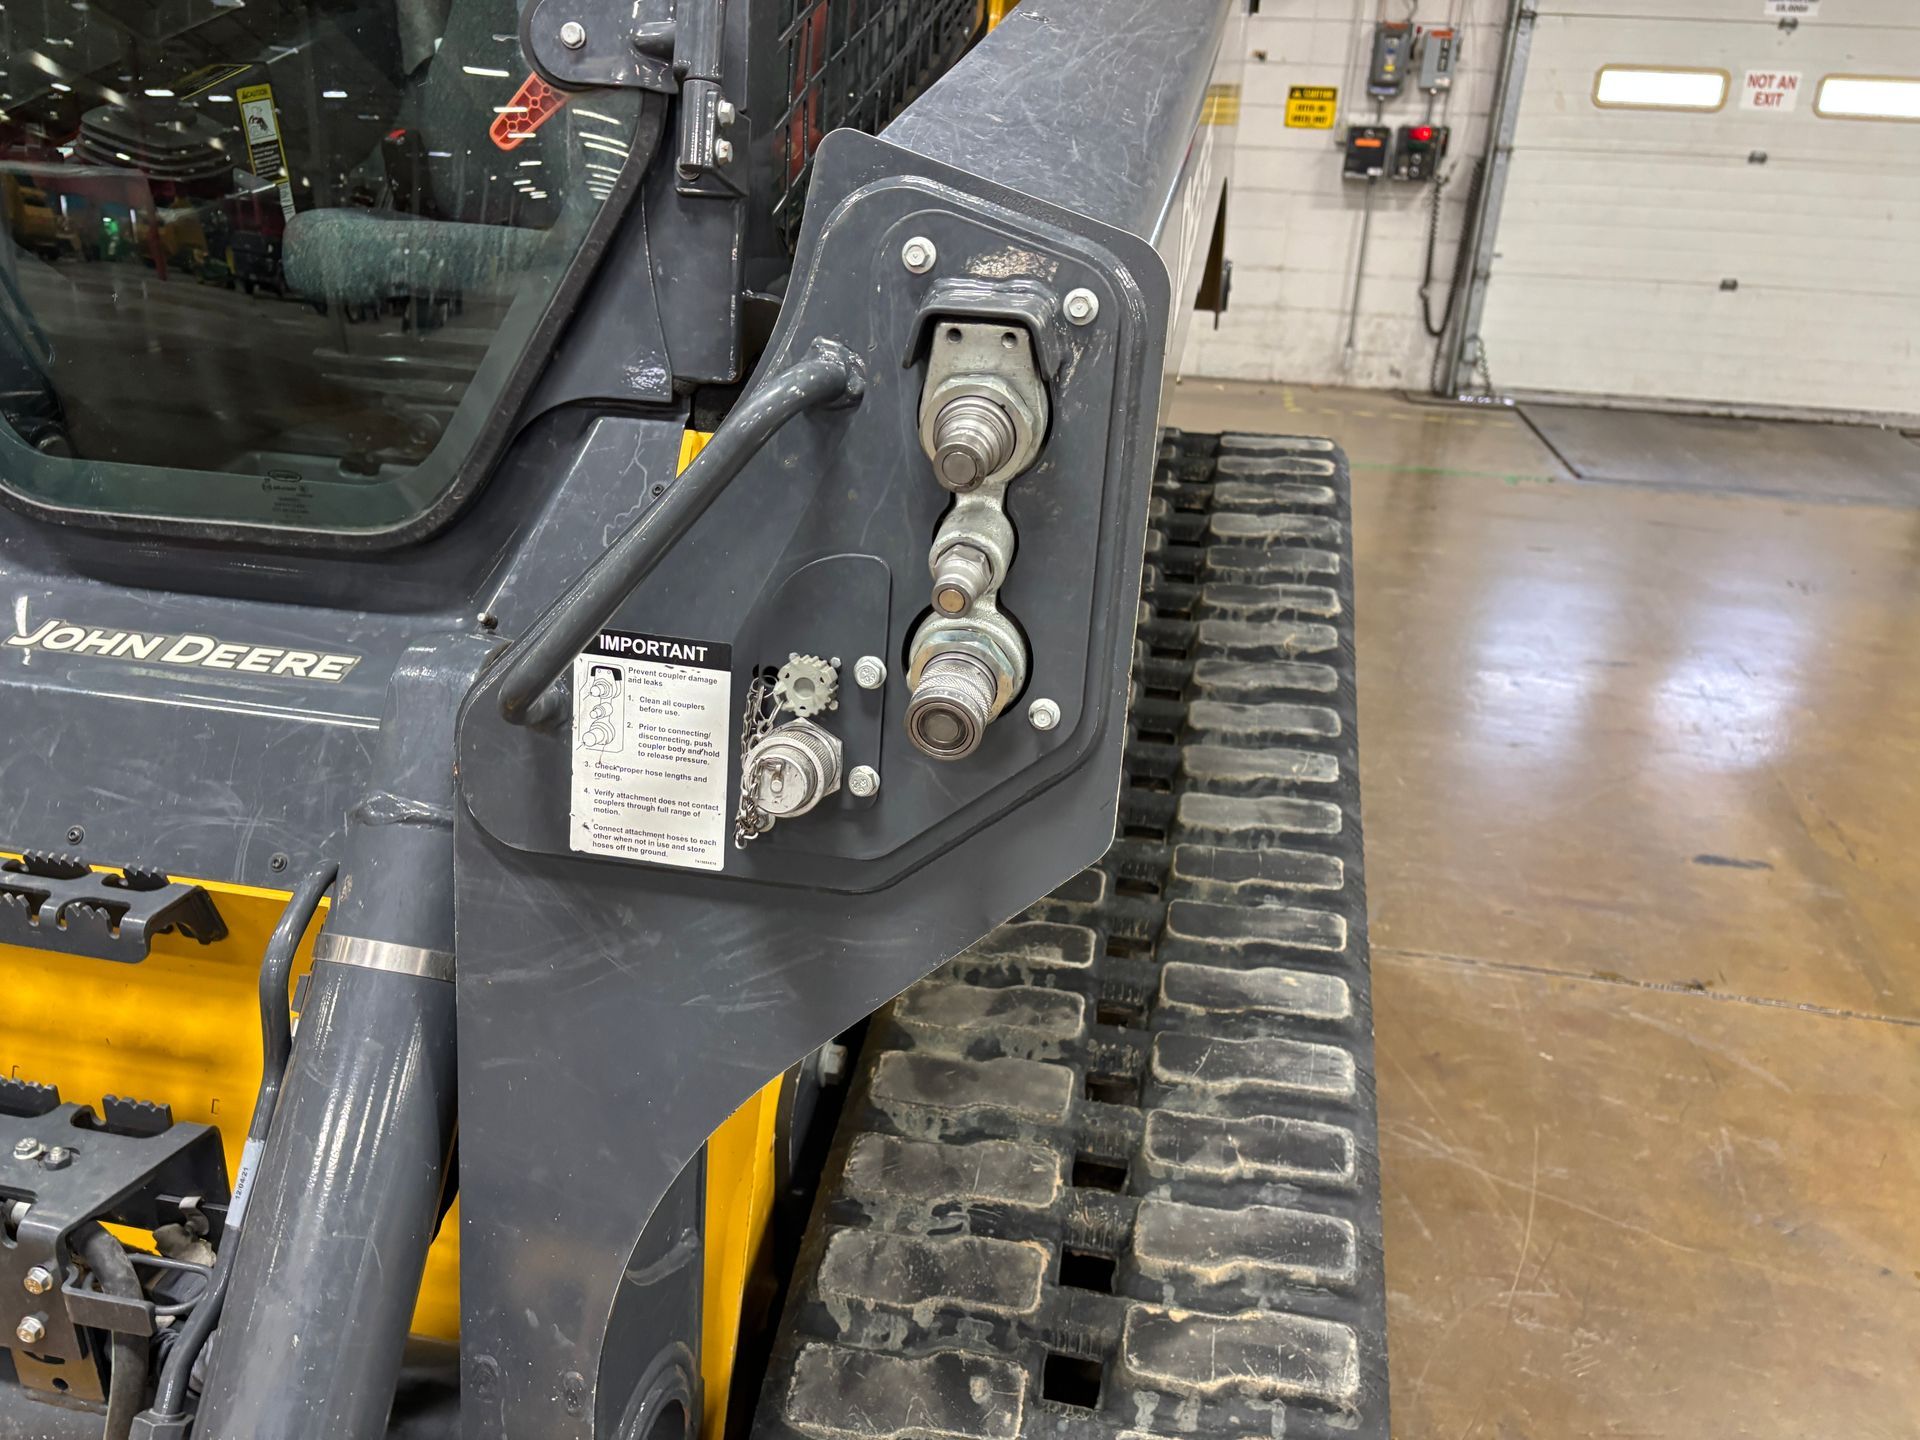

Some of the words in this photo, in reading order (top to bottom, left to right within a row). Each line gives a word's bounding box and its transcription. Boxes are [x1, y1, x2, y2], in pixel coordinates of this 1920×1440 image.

[1748, 74, 1776, 88] NOT
[1778, 75, 1797, 90] AN
[1754, 92, 1784, 107] EXIT
[7, 620, 165, 660] JOHN
[160, 635, 355, 680] DEERE
[600, 634, 708, 662] IMPORTANT
[628, 667, 657, 677] Prevent
[659, 672, 686, 680] coupler
[688, 674, 717, 684] damage
[644, 678, 662, 686] leaks
[640, 706, 662, 714] before
[673, 701, 705, 710] couplers
[639, 724, 656, 732] Prior
[668, 727, 711, 738] connecting/
[638, 733, 692, 746] disconnecting,
[638, 742, 665, 751] coupler
[668, 745, 685, 754] body
[703, 749, 719, 757] hold
[647, 752, 673, 760] release
[676, 756, 709, 765] pressure.
[594, 772, 622, 781] routing.
[620, 766, 643, 775] proper
[665, 771, 691, 781] lengths
[594, 789, 614, 798] Verify
[617, 792, 656, 803] attachment
[692, 802, 719, 811] contact
[593, 807, 620, 815] motion.
[594, 798, 625, 808] couplers
[627, 802, 655, 811] through
[657, 805, 669, 813] full
[671, 808, 691, 817] range
[593, 824, 623, 832] Connect
[625, 827, 664, 839] attachment
[700, 838, 716, 846] each
[593, 833, 611, 841] other
[640, 848, 668, 857] ground.
